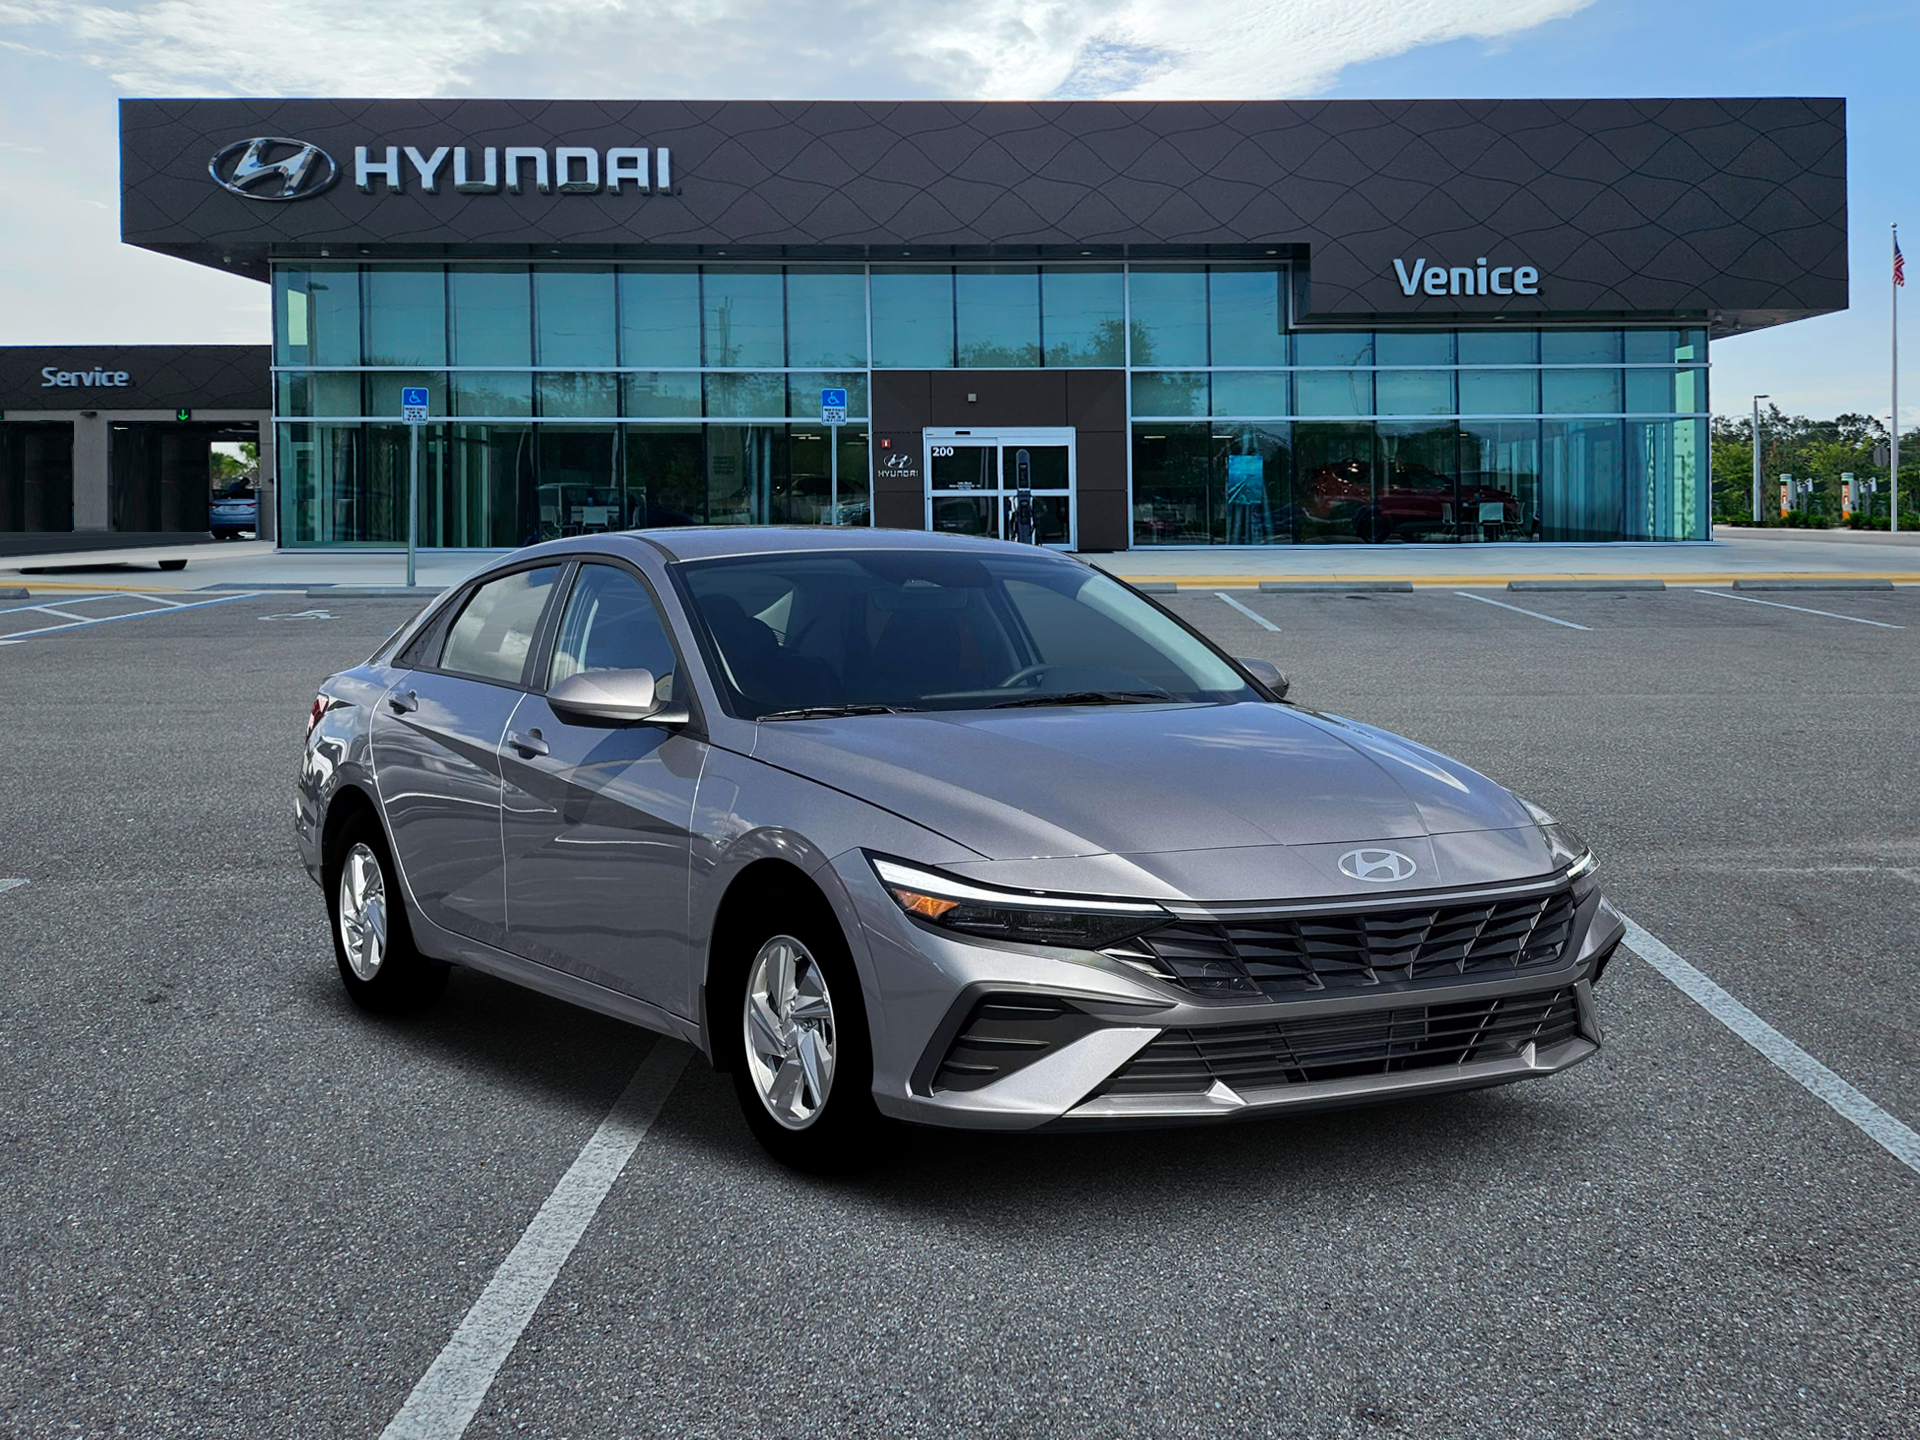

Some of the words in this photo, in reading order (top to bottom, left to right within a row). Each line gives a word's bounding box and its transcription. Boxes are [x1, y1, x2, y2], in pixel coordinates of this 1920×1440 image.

[355, 146, 670, 193] HYUNDAI
[1393, 257, 1538, 295] Venice
[41, 366, 130, 387] Service
[932, 447, 954, 457] 200
[877, 470, 919, 478] HYUNDAI
